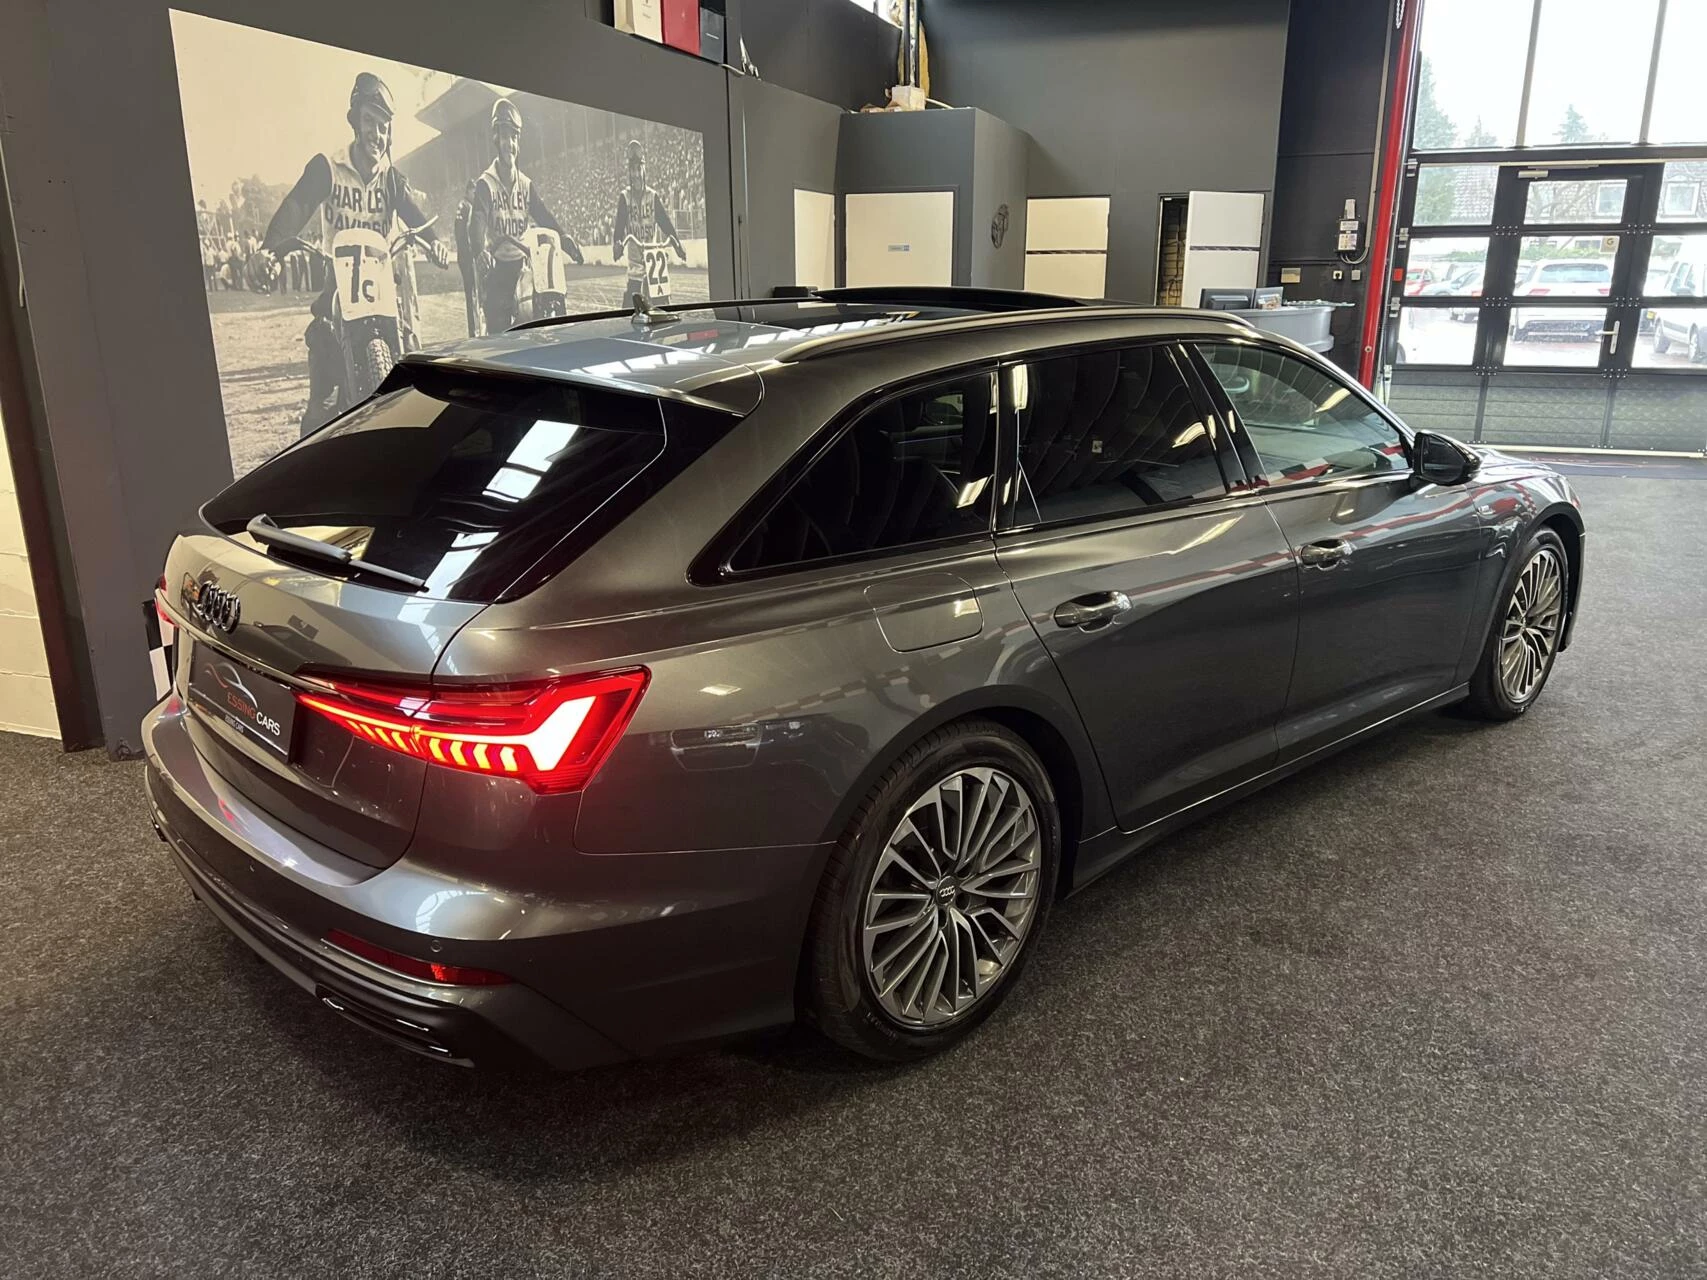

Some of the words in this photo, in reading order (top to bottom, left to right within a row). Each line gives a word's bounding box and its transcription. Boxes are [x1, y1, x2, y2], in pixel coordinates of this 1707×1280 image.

[646, 251, 669, 286] 22
[227, 692, 256, 719] ESSING
[256, 712, 280, 736] CARS
